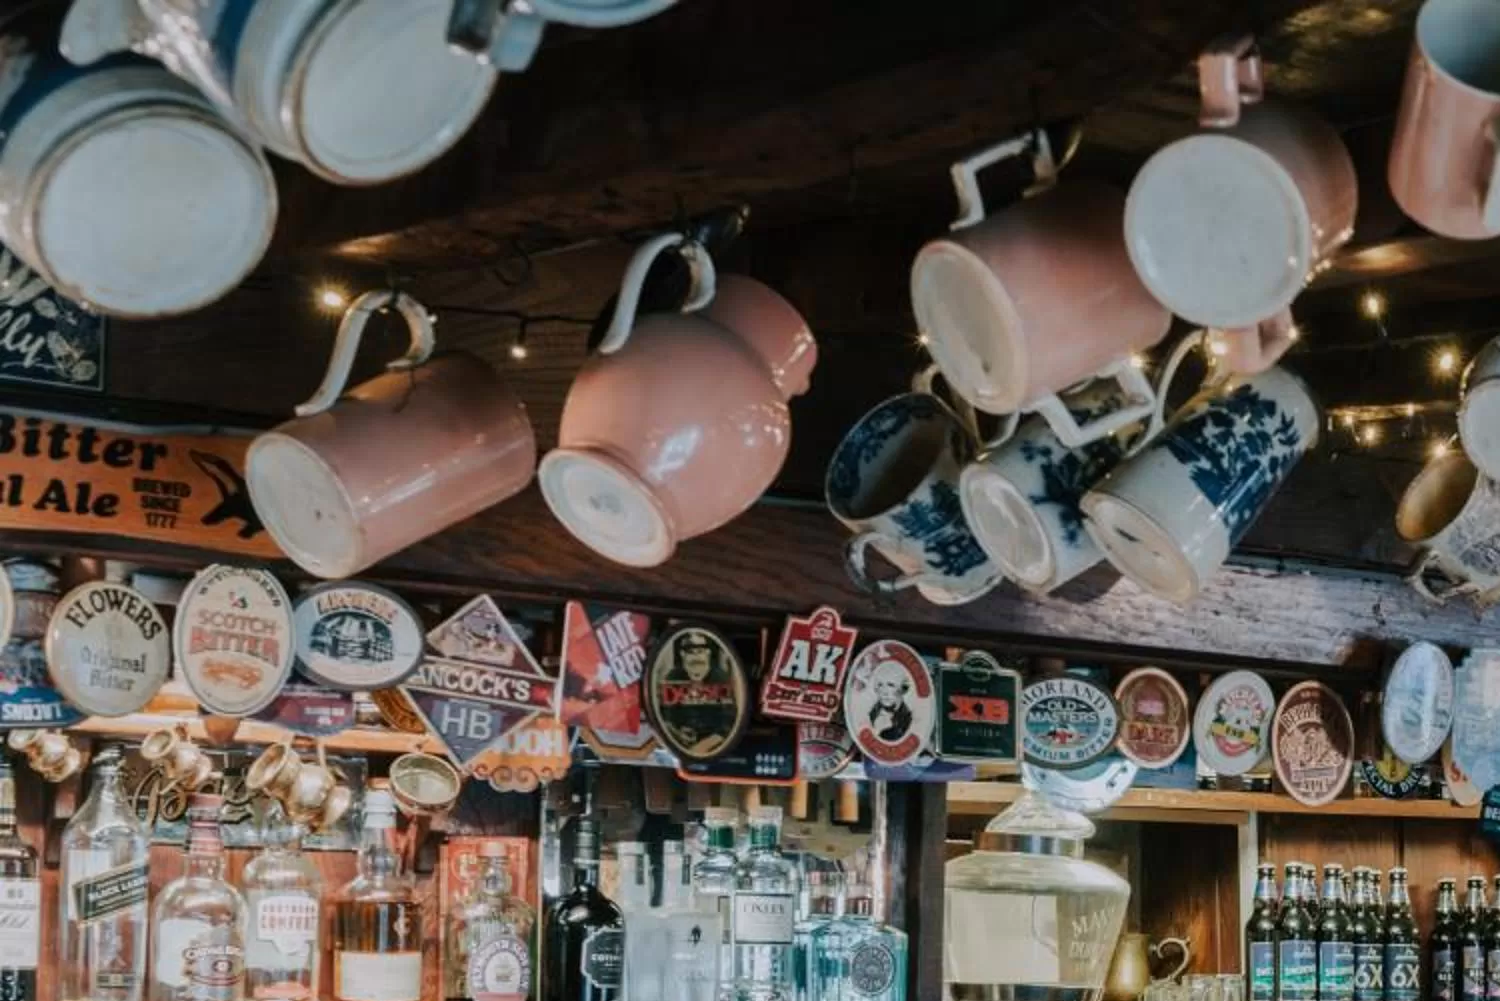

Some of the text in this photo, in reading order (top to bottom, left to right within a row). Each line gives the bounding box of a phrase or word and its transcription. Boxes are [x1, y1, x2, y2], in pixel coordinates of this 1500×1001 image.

[33, 479, 120, 517] Ale
[133, 478, 192, 498] BREWED
[141, 496, 181, 512] SINCE
[144, 513, 177, 529] 1777
[66, 588, 163, 641] FLOWERS
[199, 610, 276, 635] SCOTCH
[595, 610, 640, 657] LATE
[189, 626, 281, 669] BITTER
[779, 638, 844, 685] AK
[408, 662, 532, 701] ANCOCK'S
[1028, 710, 1099, 723] MASTERS
[1047, 700, 1077, 711] OLD
[440, 703, 493, 740] HB
[1355, 964, 1384, 989] 6X
[1391, 964, 1420, 989] 6X
